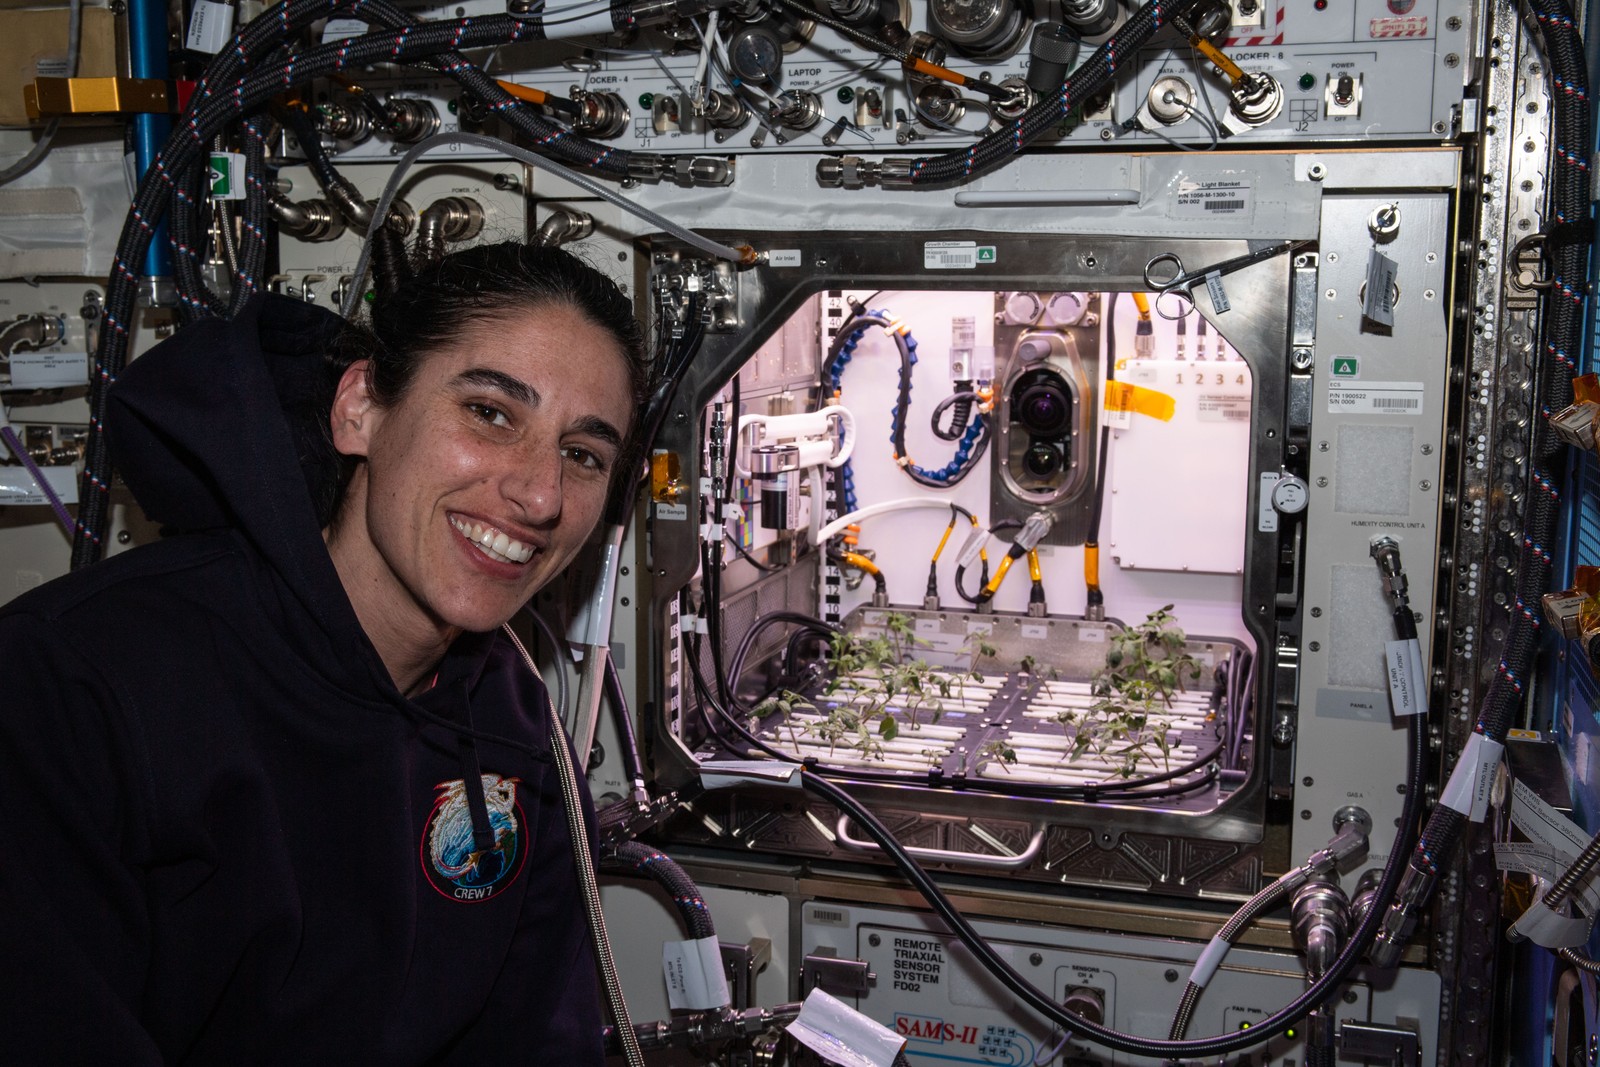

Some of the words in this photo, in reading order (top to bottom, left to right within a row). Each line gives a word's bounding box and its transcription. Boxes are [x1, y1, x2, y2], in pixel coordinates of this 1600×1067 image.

[191, 11, 199, 36] NITROGEN
[1230, 52, 1269, 61] LOCKER
[1295, 122, 1309, 132] J2
[1057, 128, 1073, 137] G2
[449, 143, 462, 151] G1
[641, 139, 651, 147] J1
[317, 265, 343, 273] POWER
[830, 299, 841, 308] 42
[830, 318, 841, 326] 40
[1176, 373, 1183, 384] 1
[1196, 373, 1204, 384] 2
[1216, 374, 1224, 385] 3
[1236, 374, 1244, 385] 4
[828, 567, 839, 576] 14
[828, 586, 839, 595] 12
[828, 605, 839, 614] 10
[1390, 668, 1399, 683] UNIT
[1400, 677, 1409, 708] CONTROL
[1479, 775, 1487, 796] OUTLET
[1516, 782, 1528, 792] JEM
[1523, 795, 1537, 809] Flow
[1539, 807, 1560, 828] Sensor
[1561, 825, 1584, 846] 380mm
[454, 887, 485, 900] CREW
[486, 885, 493, 896] 7
[894, 938, 942, 952] REMOTE
[894, 949, 945, 963] TRIAXIAL
[894, 960, 940, 973] SENSOR
[1072, 965, 1100, 973] SENSORS
[894, 970, 939, 984] SYSTEM
[894, 981, 920, 992] FD02
[896, 1017, 979, 1044] SAMS-II
